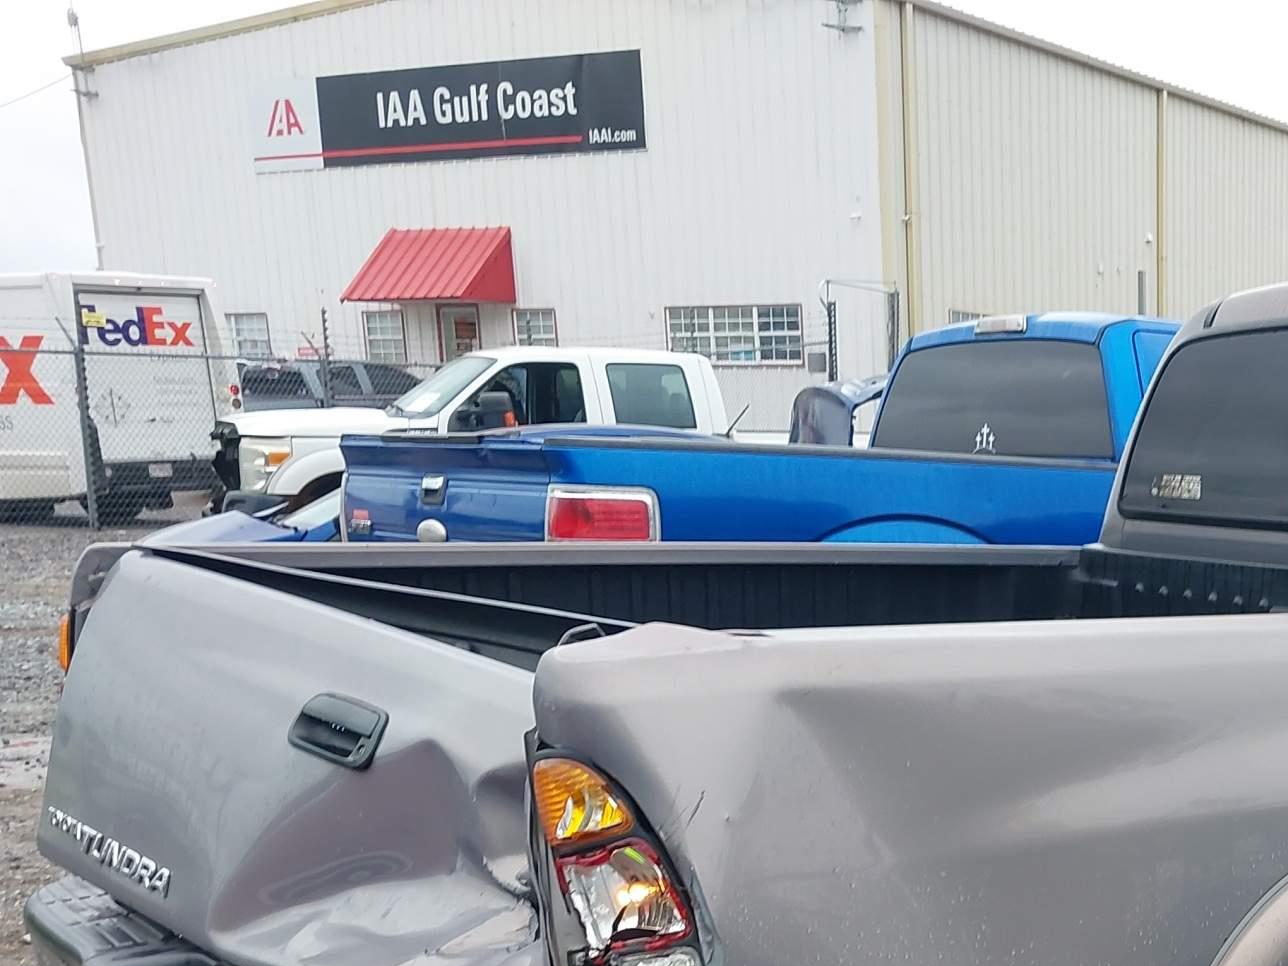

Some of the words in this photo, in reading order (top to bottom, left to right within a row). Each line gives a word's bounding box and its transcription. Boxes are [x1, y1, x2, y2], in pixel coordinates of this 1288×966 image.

[376, 89, 427, 128] IAA
[433, 83, 489, 125] Gulf
[497, 80, 578, 121] Coast
[588, 127, 637, 145] IAAI.com
[80, 822, 172, 899] TUNDRA
